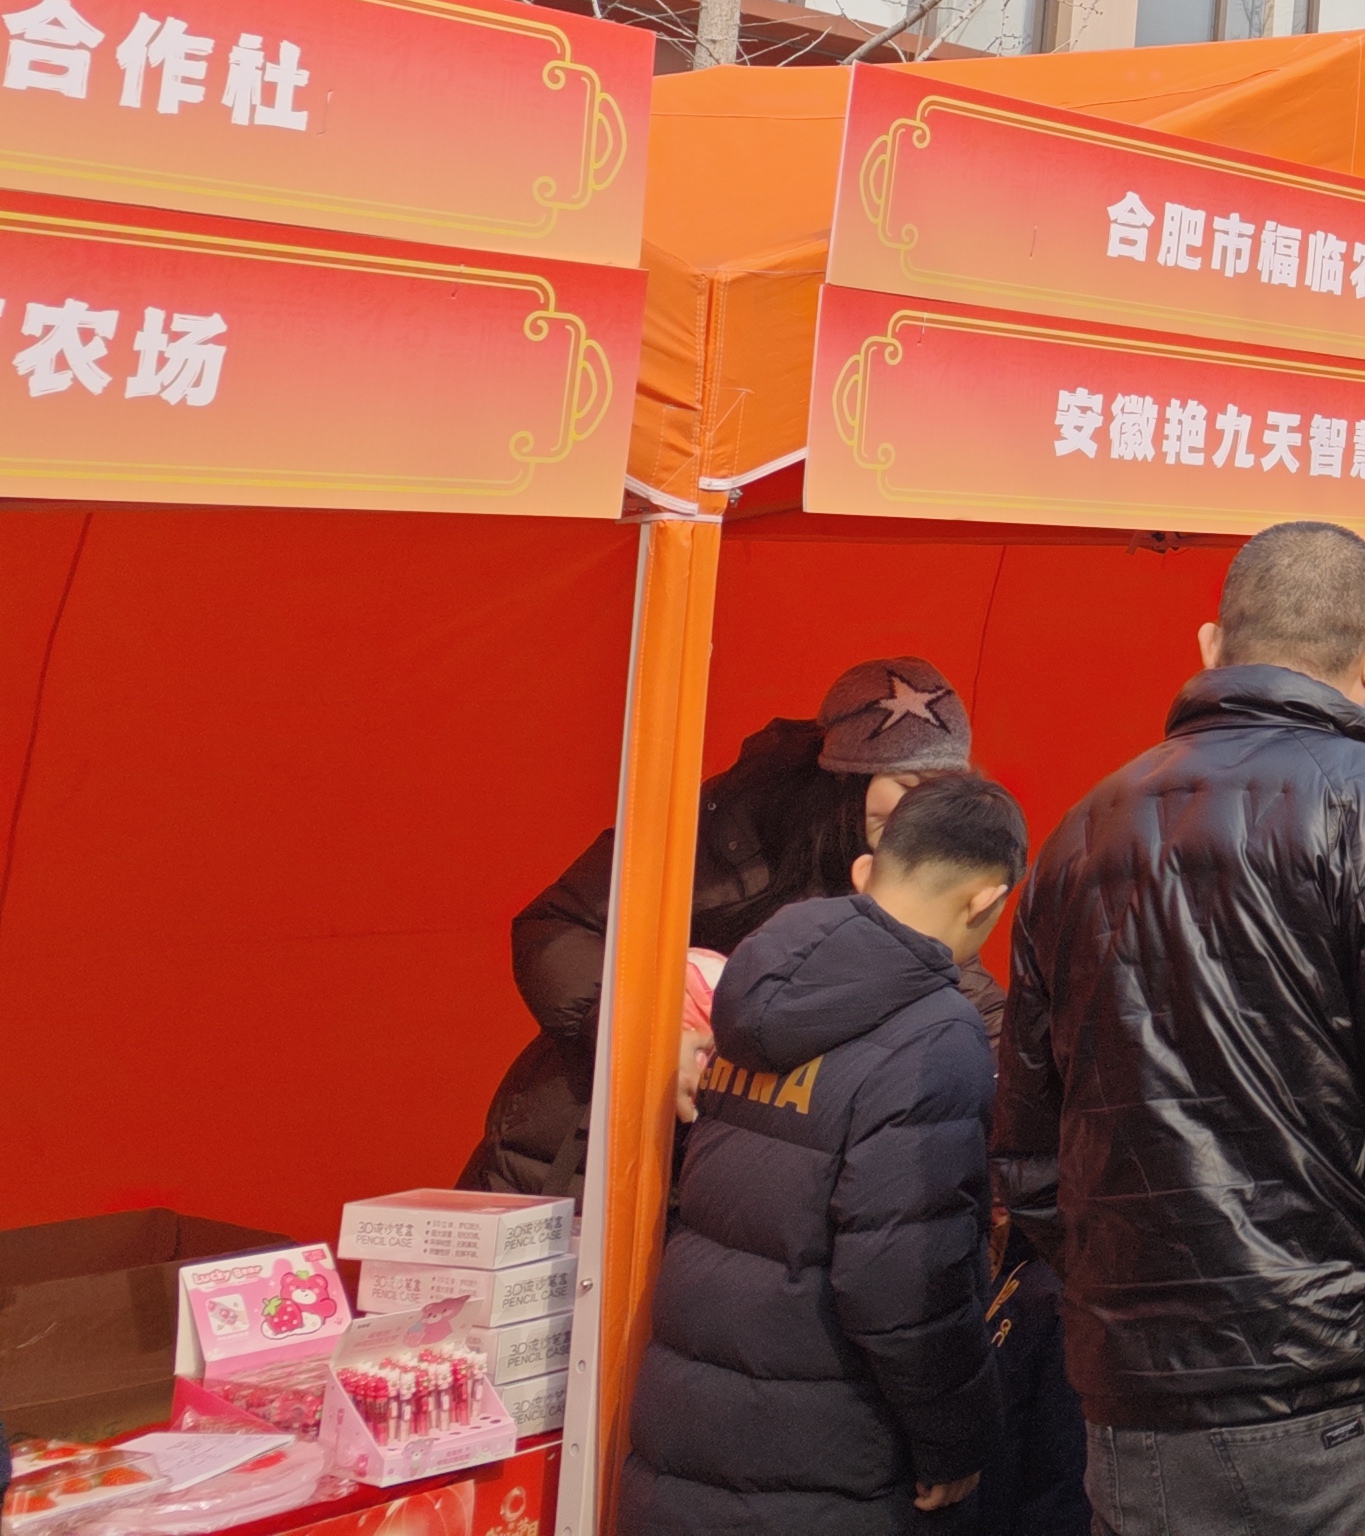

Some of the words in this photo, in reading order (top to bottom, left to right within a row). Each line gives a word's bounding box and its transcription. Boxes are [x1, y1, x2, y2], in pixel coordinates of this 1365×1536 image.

[0, 298, 227, 407] 农场
[357, 1221, 415, 1237] 3D流沙笔盒
[506, 1216, 563, 1240] 3D流沙笔盒
[355, 1236, 387, 1246] PENCIL
[388, 1237, 413, 1248] CASE
[504, 1236, 536, 1251] PENCIL
[539, 1230, 562, 1243] CASE
[192, 1268, 231, 1285] Lucky
[232, 1265, 263, 1279] Bear
[371, 1288, 398, 1300] PENCIL
[399, 1291, 421, 1302] CASE
[502, 1295, 538, 1309] PENCIL
[541, 1287, 568, 1300] CASE
[507, 1352, 543, 1368] PENCIL
